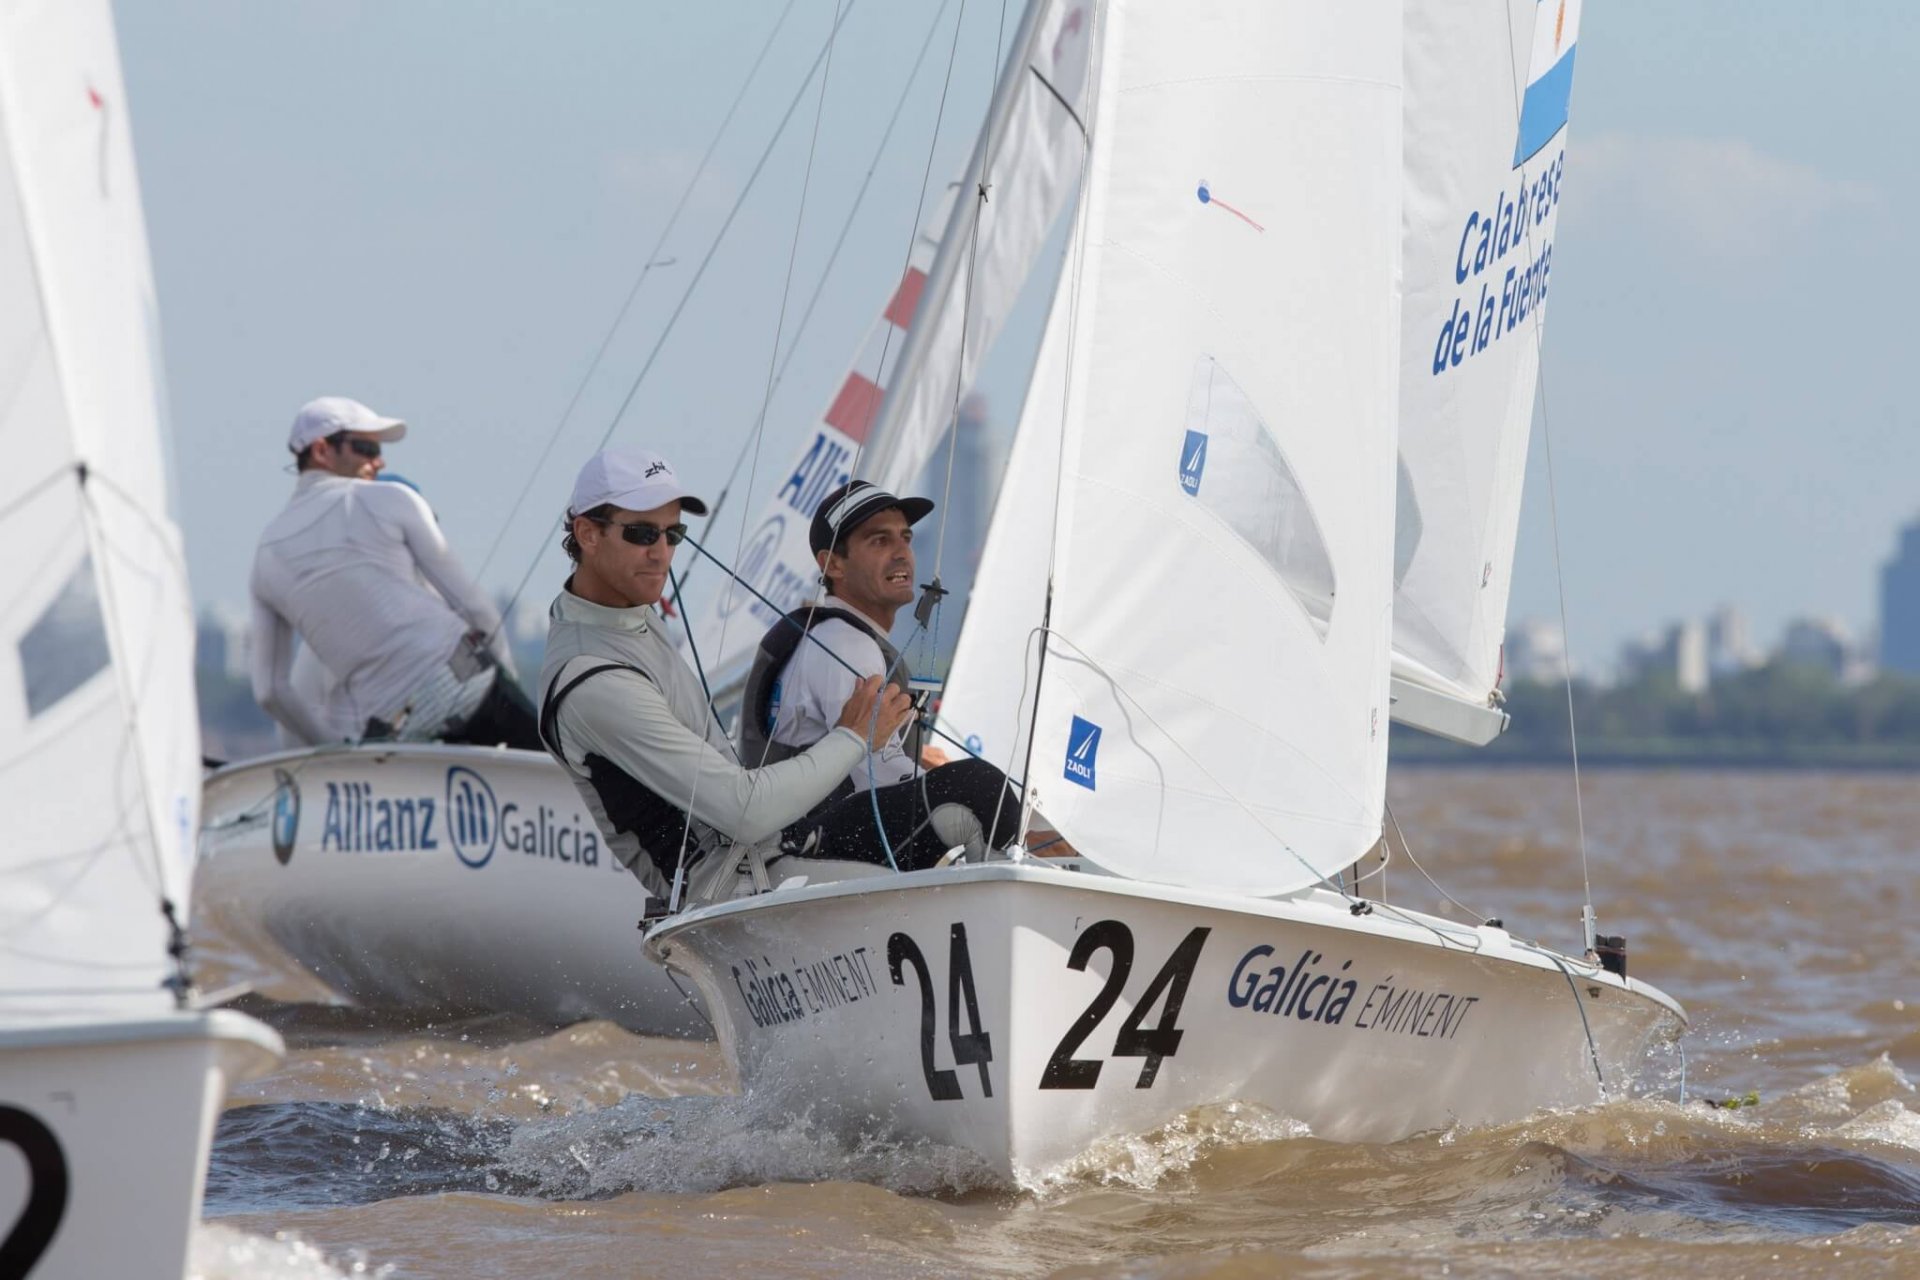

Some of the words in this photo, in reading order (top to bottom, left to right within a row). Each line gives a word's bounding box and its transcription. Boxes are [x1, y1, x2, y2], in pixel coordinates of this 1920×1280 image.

[1456, 150, 1564, 284] Calabrese
[1432, 298, 1470, 376] de
[1470, 282, 1495, 357] la
[1496, 239, 1552, 341] Fuente
[322, 782, 437, 853] Allianz
[501, 804, 599, 868] Galicia
[1066, 759, 1091, 779] ZAOLI
[731, 955, 805, 1028] Galicia
[793, 947, 878, 1014] ÉMINENT
[887, 922, 993, 1101] 24
[1038, 919, 1212, 1090] 24
[1227, 944, 1358, 1025] Galicia
[1355, 975, 1479, 1040] ÉMINENT
